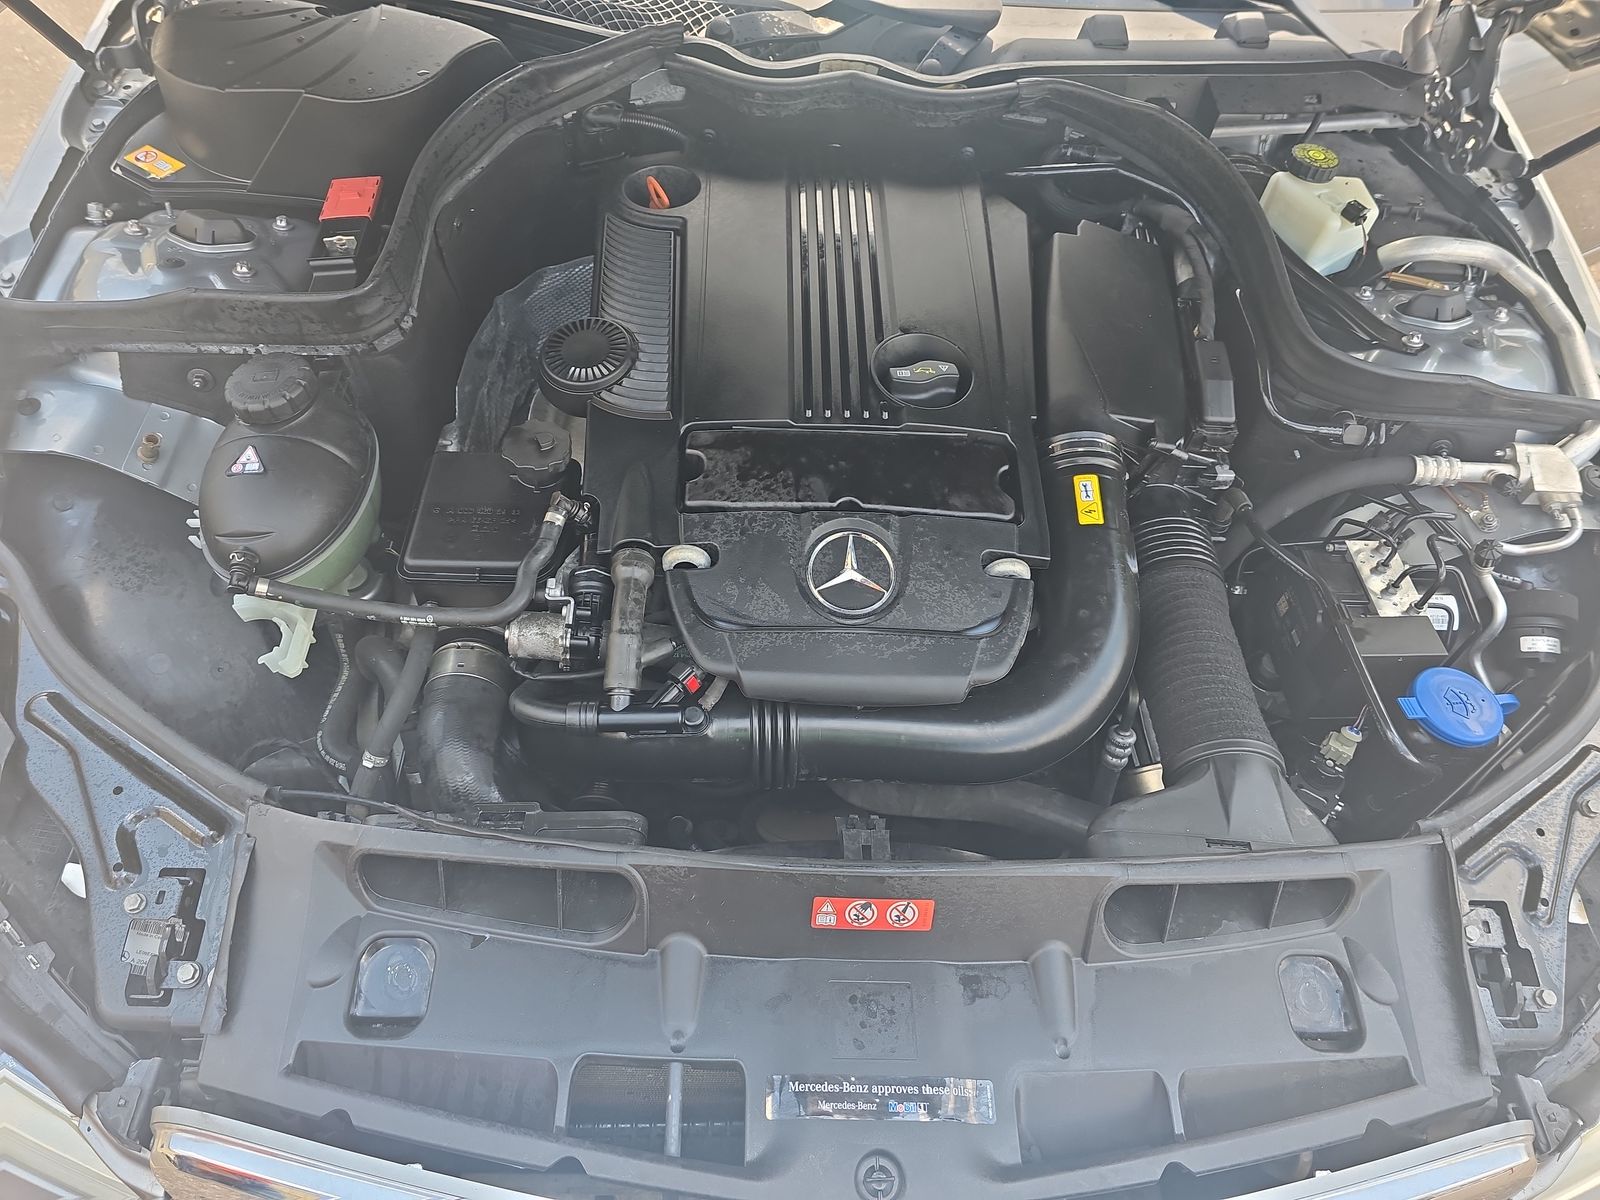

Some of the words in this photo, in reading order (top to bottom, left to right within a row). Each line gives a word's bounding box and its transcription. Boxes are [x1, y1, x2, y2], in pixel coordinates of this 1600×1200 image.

[788, 1081, 869, 1093] Mercedes-Benz
[871, 1083, 919, 1096] approves
[921, 1083, 950, 1095] these
[818, 1100, 877, 1110] Mercedes-Benz
